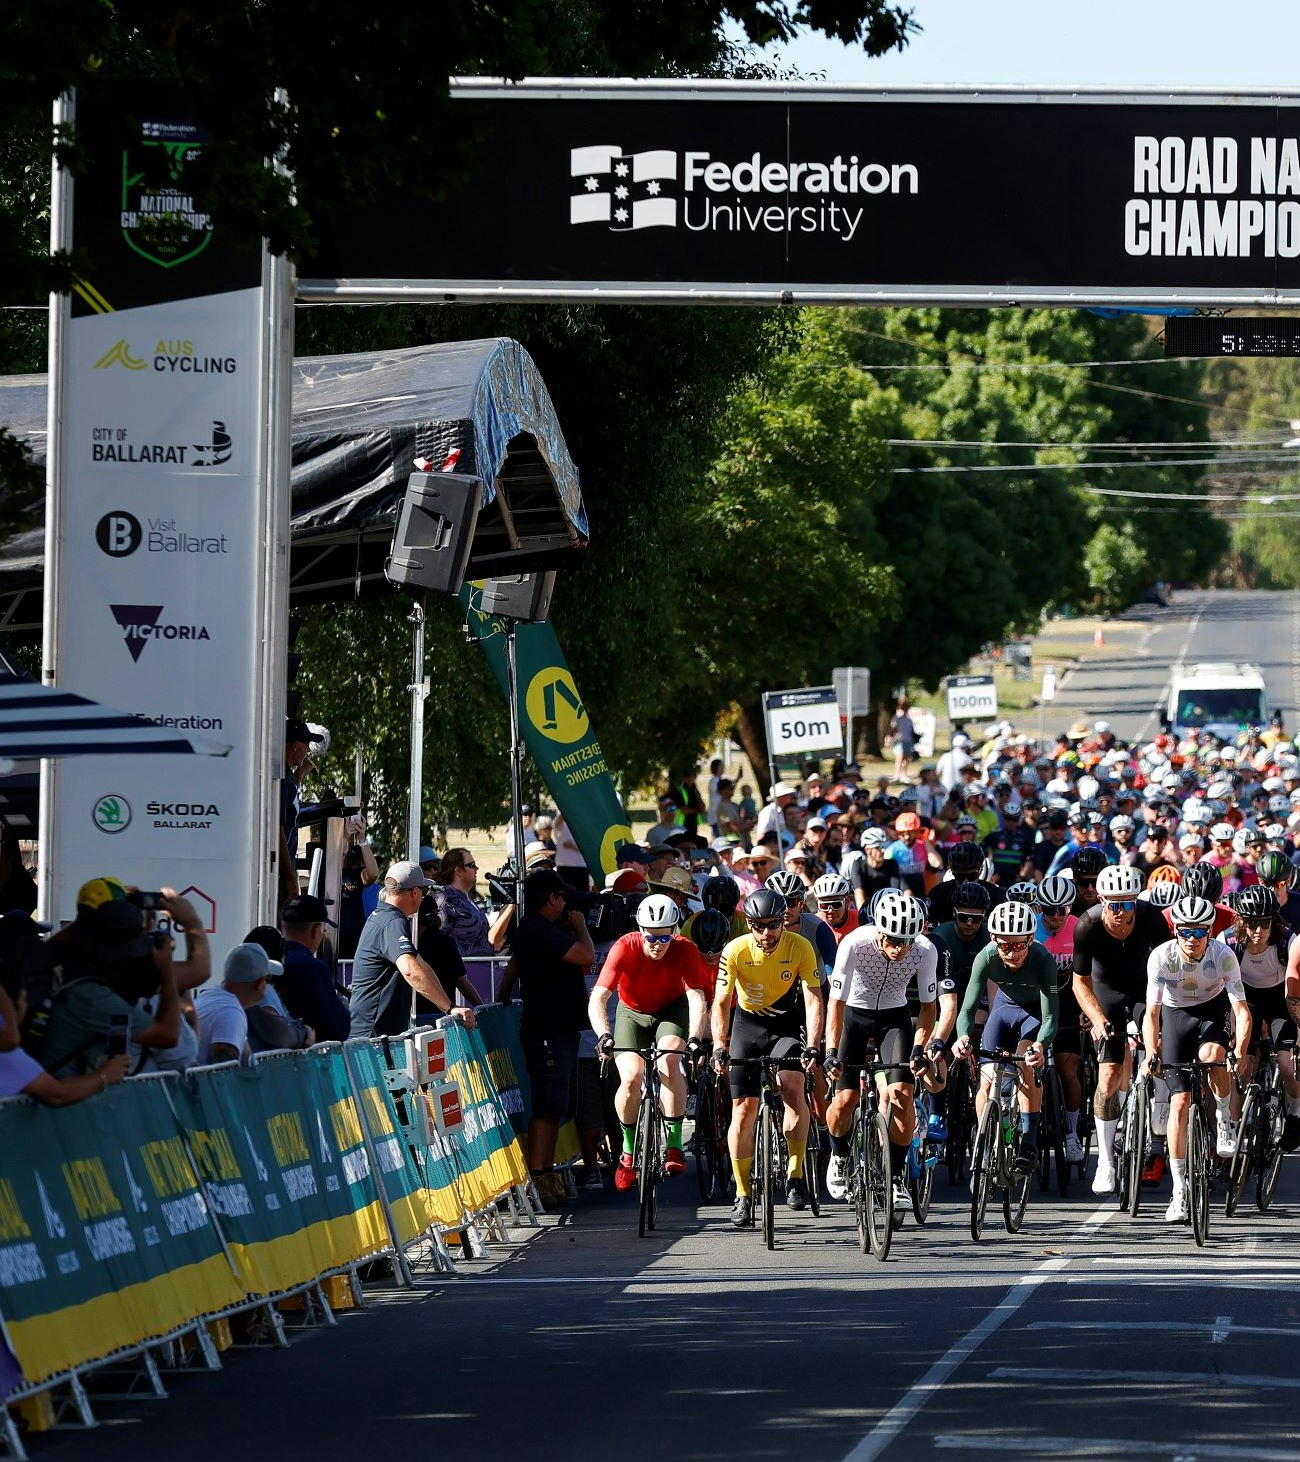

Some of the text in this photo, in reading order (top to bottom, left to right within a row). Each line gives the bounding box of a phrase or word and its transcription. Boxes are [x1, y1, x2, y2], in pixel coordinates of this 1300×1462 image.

[685, 152, 918, 194] Federation
[1134, 136, 1238, 194] ROAD
[140, 195, 195, 213] NATIONAL
[684, 197, 863, 241] University
[155, 340, 193, 355] AUS
[154, 356, 236, 373] CYCLING
[92, 428, 127, 441] CITY OF
[93, 444, 188, 463] BALLARAT
[147, 519, 176, 532] Visit
[148, 532, 227, 553] Ballarat
[118, 624, 211, 640] VICTORIA
[953, 694, 993, 708] 100m
[782, 710, 829, 739] 50m
[146, 801, 219, 816] ŠKODA
[154, 821, 212, 829] BALLARAT
